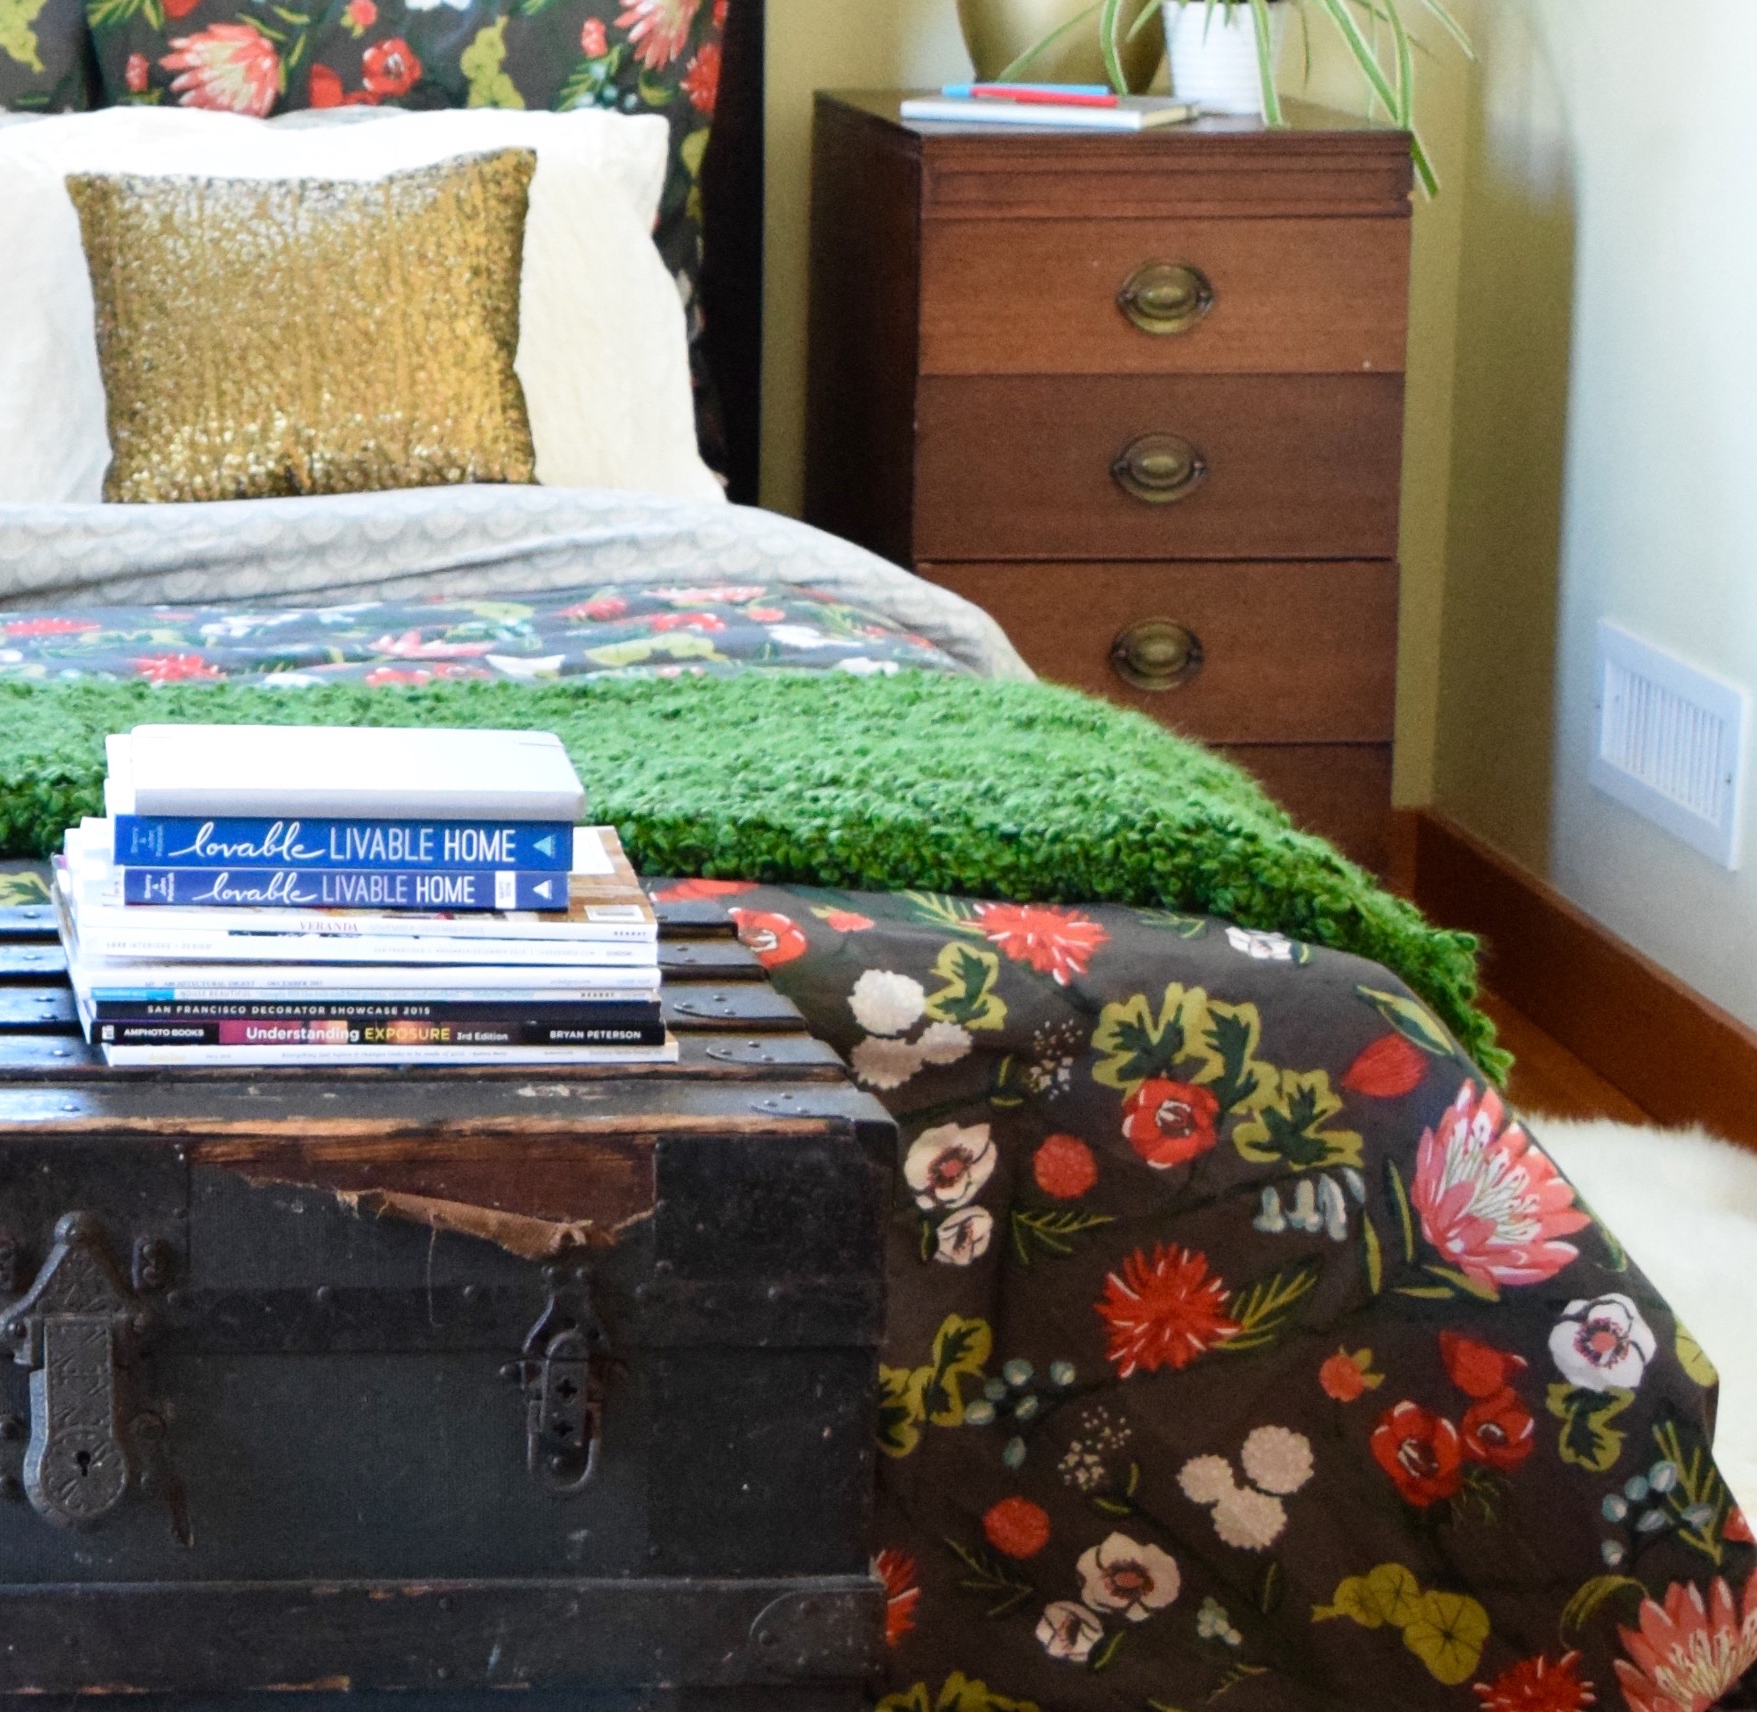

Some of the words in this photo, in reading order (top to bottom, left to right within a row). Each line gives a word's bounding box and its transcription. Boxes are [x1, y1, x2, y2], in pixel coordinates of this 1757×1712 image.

[168, 820, 326, 862] lovable
[330, 827, 434, 862] LIVABLE
[444, 828, 516, 863] HOME
[192, 871, 318, 904] lovable
[322, 874, 407, 902] LIVABLE
[416, 875, 476, 904] HOME
[299, 921, 359, 932] VERANDA
[147, 1005, 171, 1014] SAN
[176, 1005, 246, 1014] FRANCISCO
[251, 1005, 326, 1015] DECORATOR
[330, 1006, 398, 1015] SHOWCASE
[403, 1006, 431, 1015] 2015
[123, 1028, 169, 1037] AMPHOTO
[171, 1028, 204, 1037] BOOKS
[246, 1026, 360, 1043] Understanding
[364, 1027, 451, 1041] EXPOSURE
[456, 1031, 471, 1041] 3rd
[472, 1032, 509, 1042] Edition
[549, 1030, 584, 1039] BRYAN
[587, 1030, 642, 1039] PETERSON
